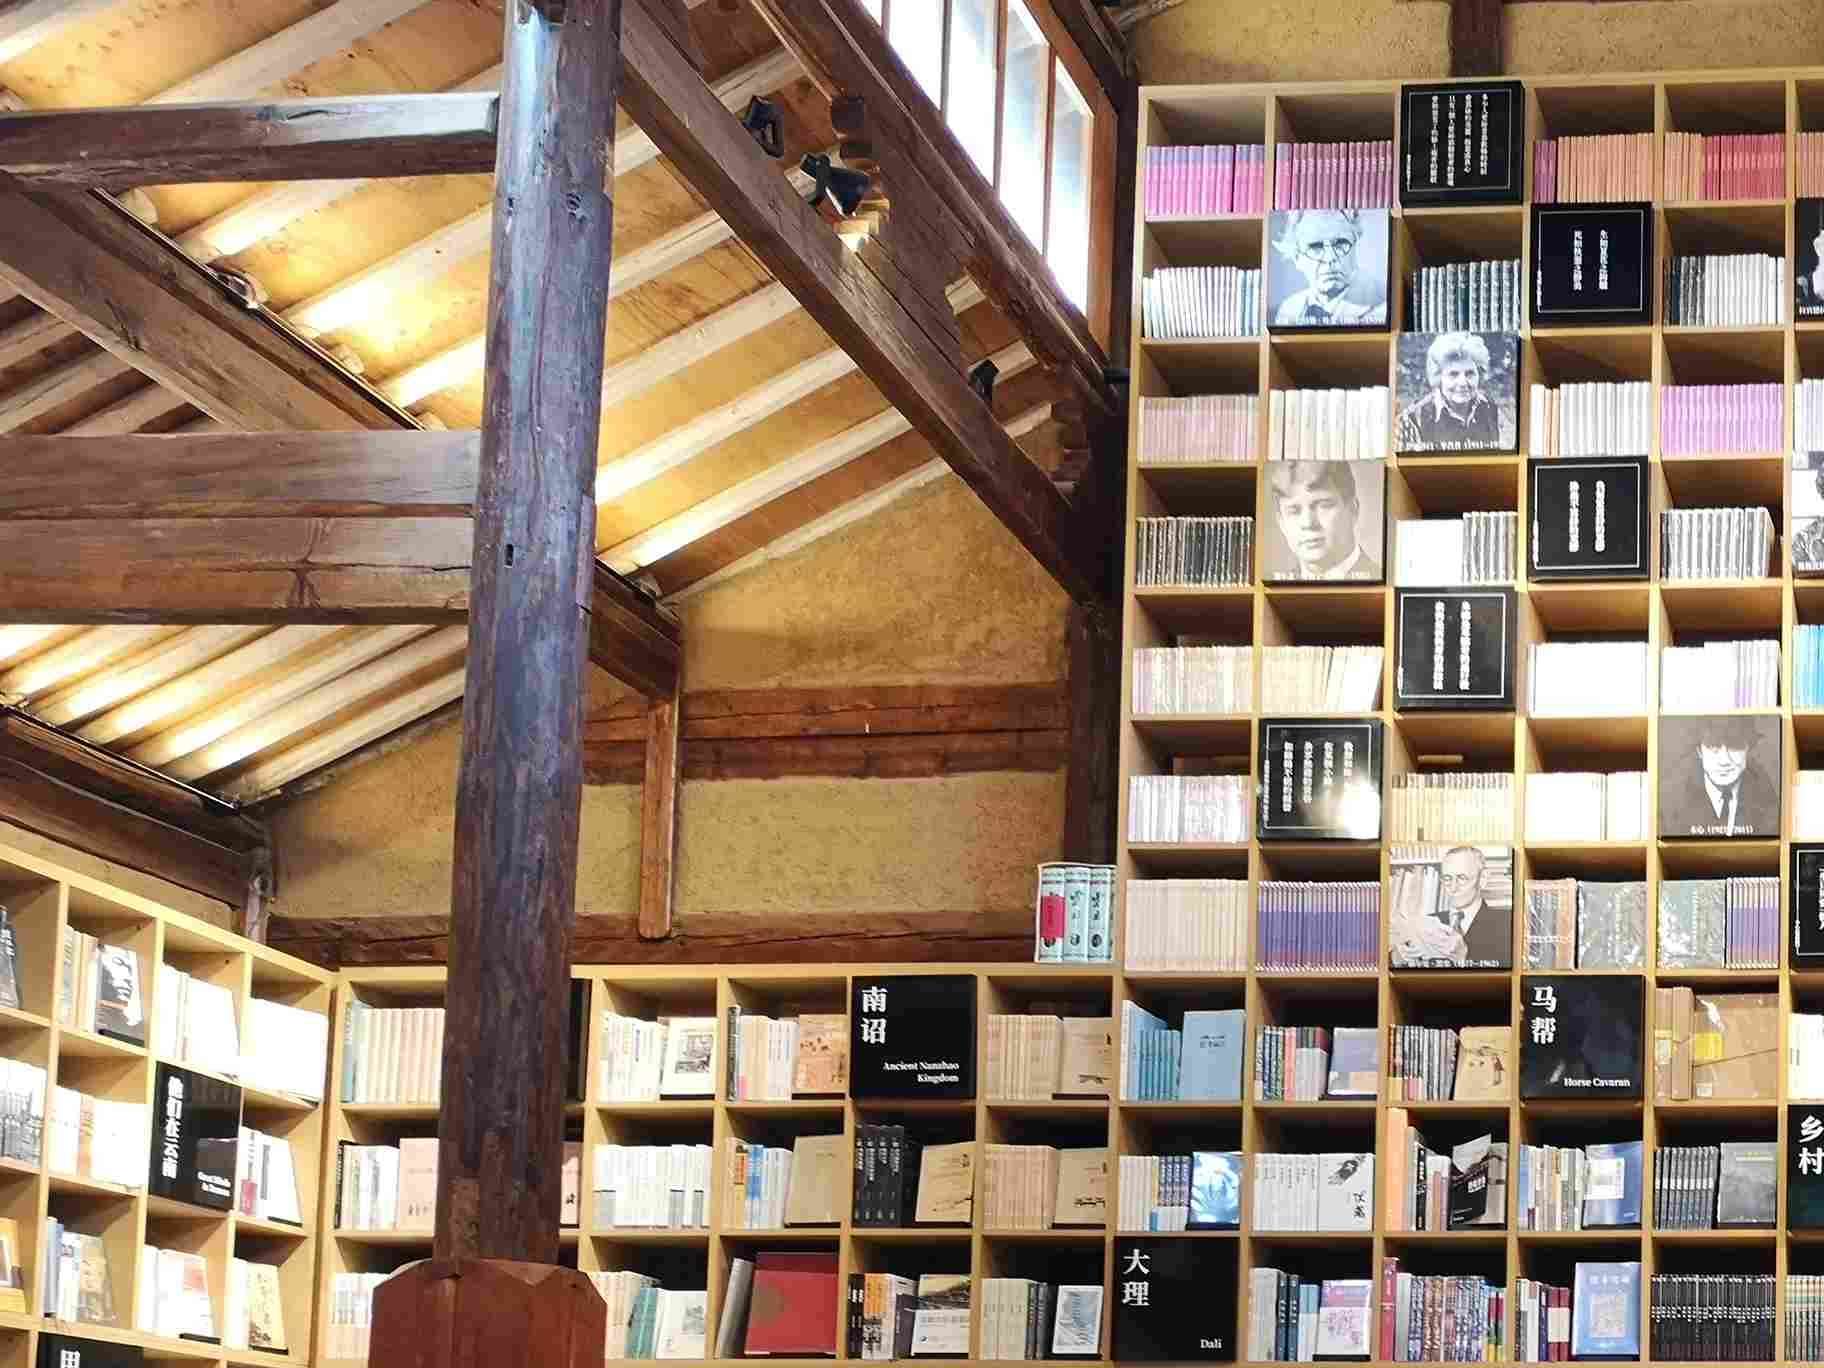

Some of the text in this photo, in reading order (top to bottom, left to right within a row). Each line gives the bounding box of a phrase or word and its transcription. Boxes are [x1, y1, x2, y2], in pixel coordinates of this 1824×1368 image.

[860, 985, 888, 1044] 南诏
[1531, 985, 1557, 1045] 马帮
[883, 1060, 918, 1072] Ancient
[917, 1073, 959, 1085] Kingdom
[1563, 1076, 1592, 1087] Horse
[1122, 1248, 1150, 1306] 大理
[1200, 1338, 1222, 1349] Dali
